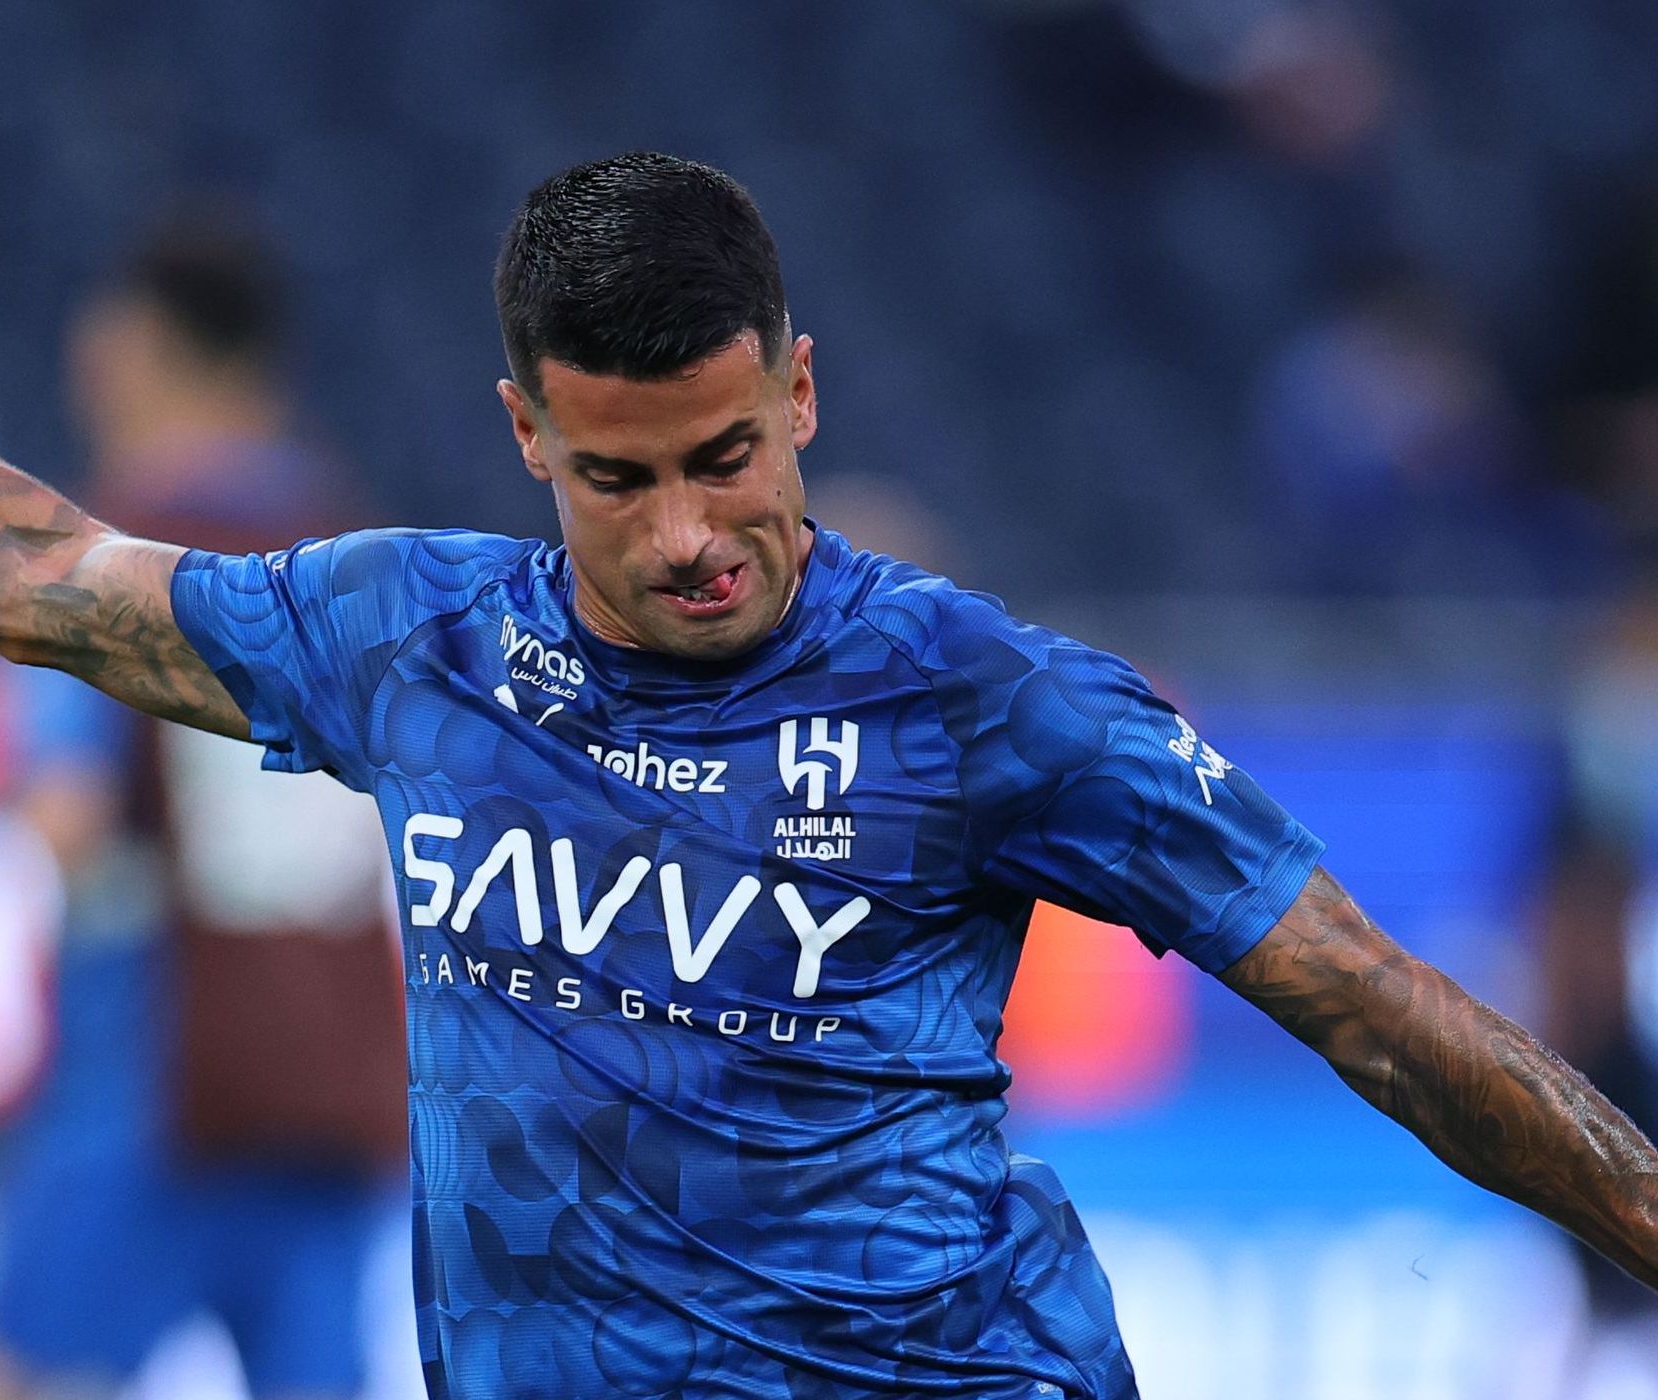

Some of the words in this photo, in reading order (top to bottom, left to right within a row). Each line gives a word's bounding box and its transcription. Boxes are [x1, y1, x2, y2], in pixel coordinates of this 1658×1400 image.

[776, 839, 851, 861] الهلال
[404, 813, 871, 998] SAVVY
[419, 953, 581, 1010] GAMES
[620, 988, 841, 1042] GROUP
